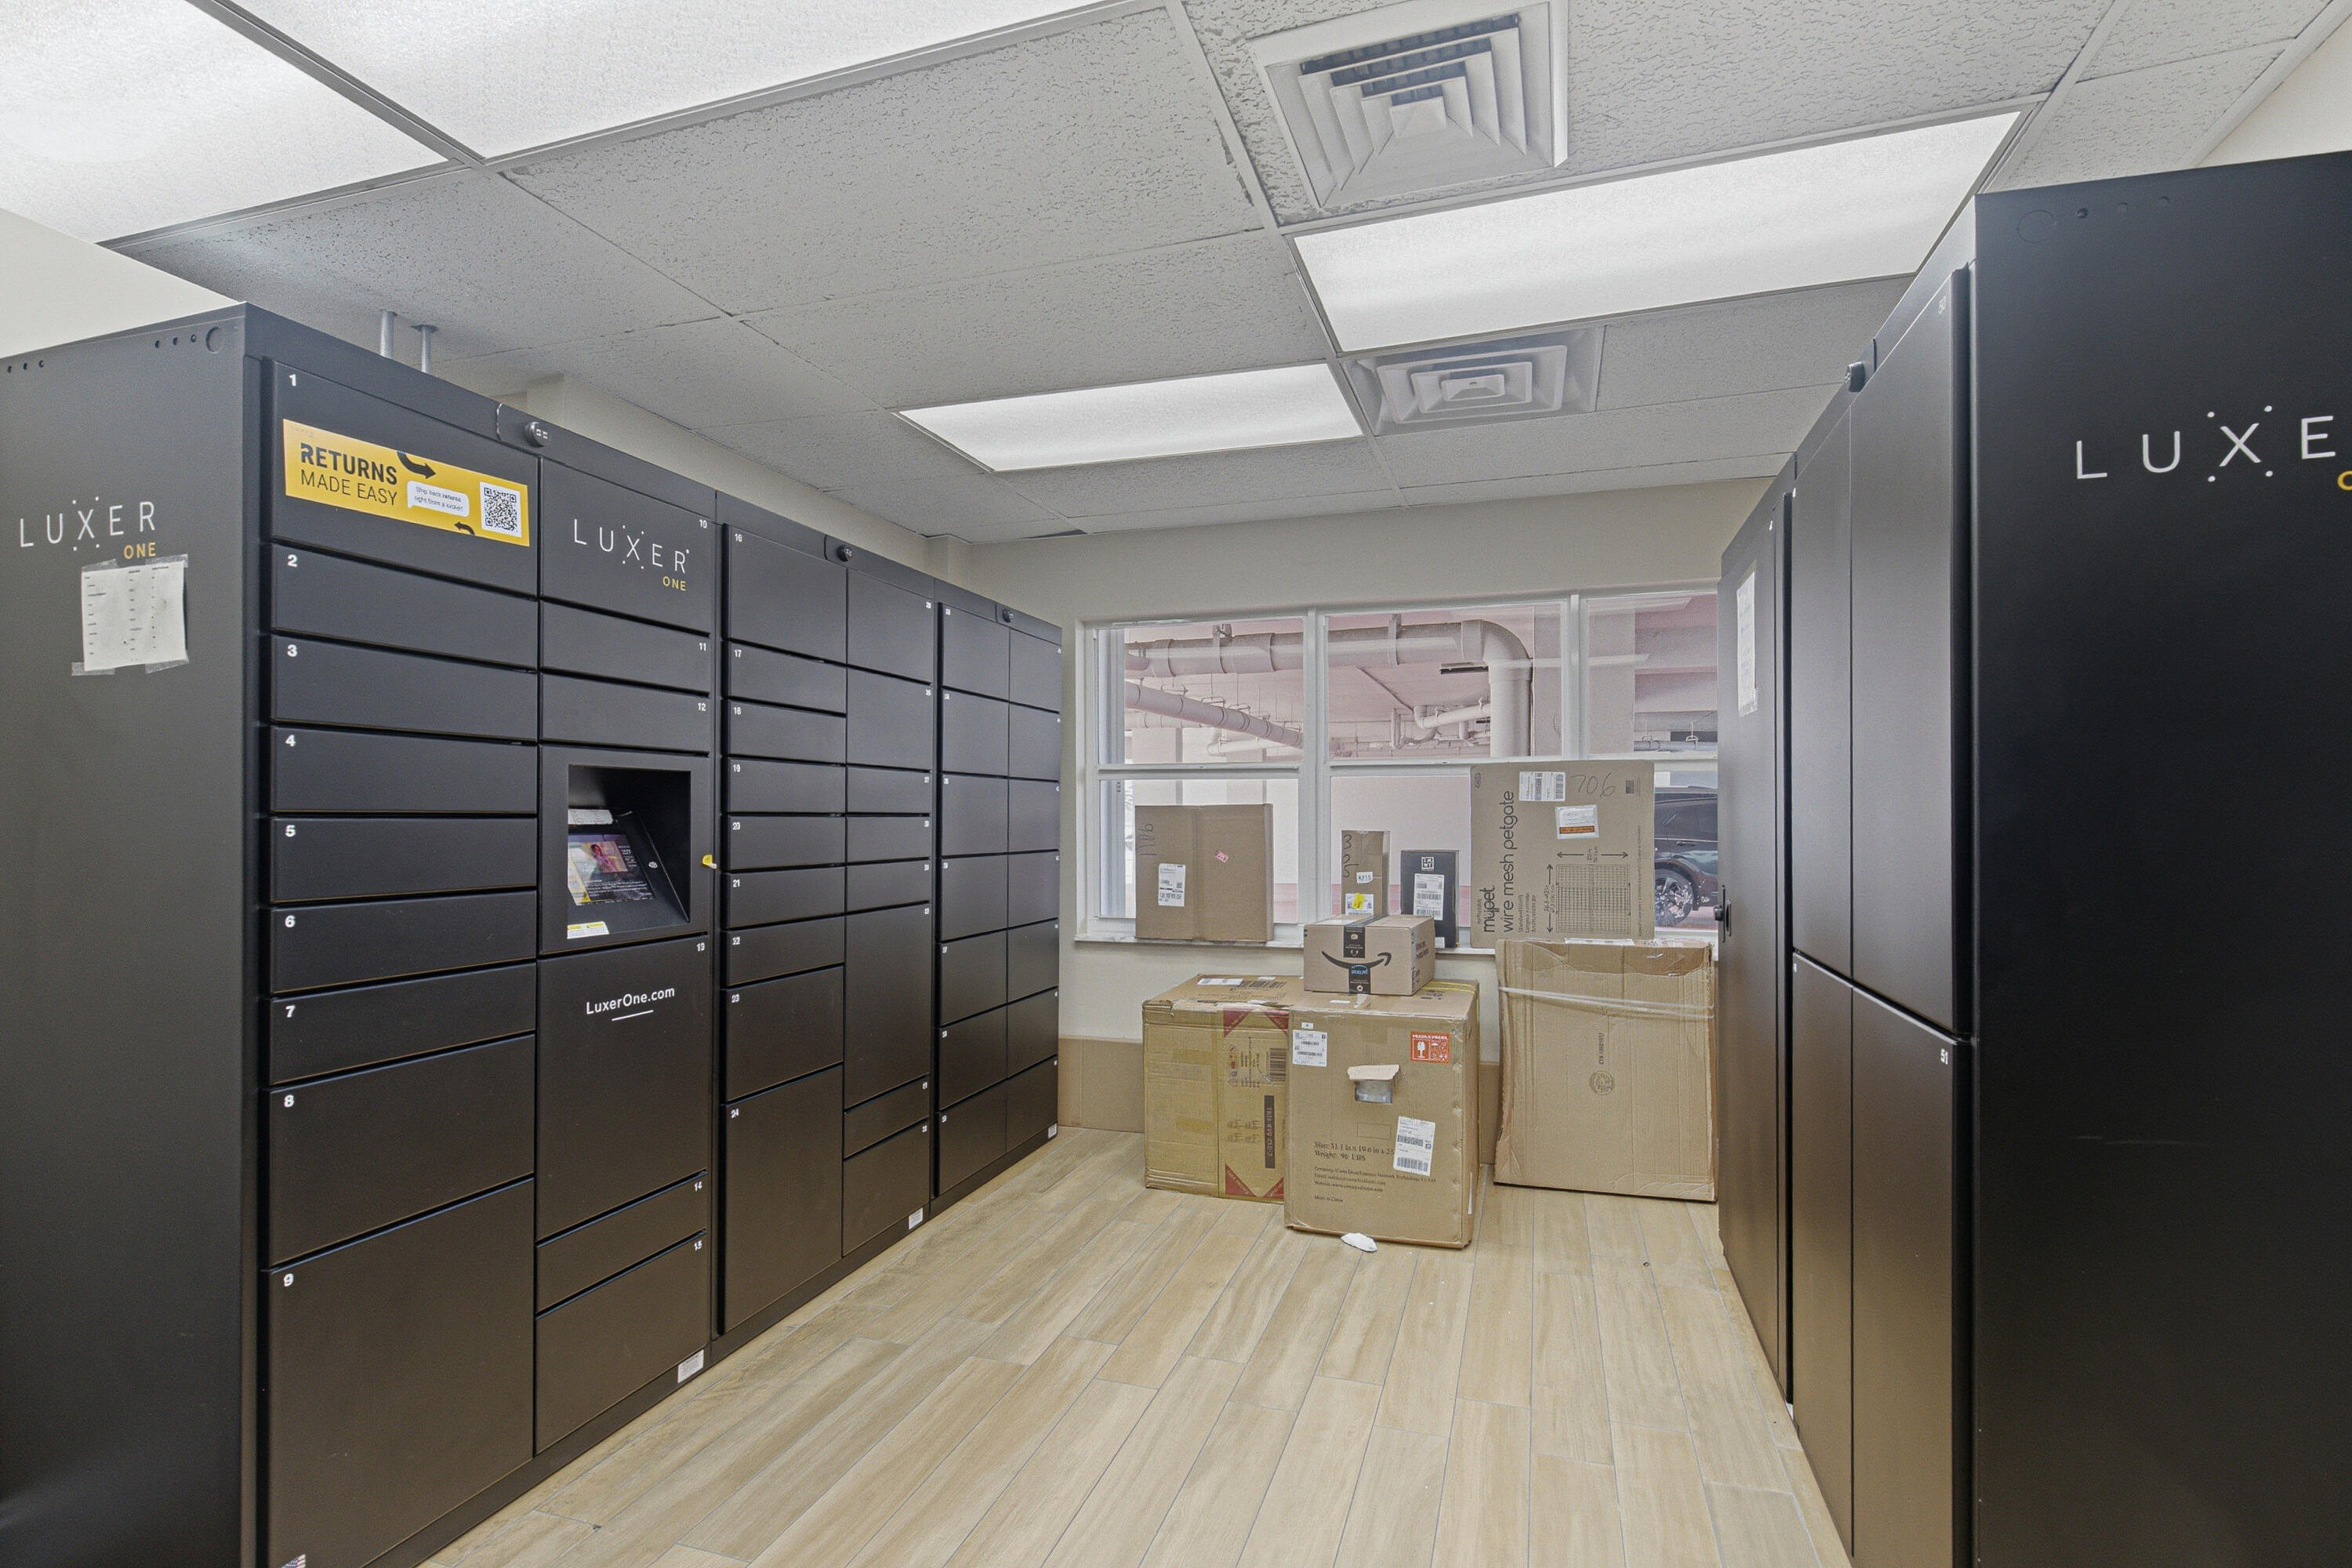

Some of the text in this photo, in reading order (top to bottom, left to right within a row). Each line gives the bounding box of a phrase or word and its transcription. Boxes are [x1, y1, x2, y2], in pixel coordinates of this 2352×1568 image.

[289, 374, 296, 387] 1
[300, 442, 397, 485] RETURNS
[301, 470, 397, 506] MADE EASY
[20, 497, 155, 550] LUXER
[699, 519, 708, 529] 10
[124, 543, 156, 559] ONE
[574, 519, 687, 573] LUXER
[287, 554, 298, 568] 2
[662, 576, 686, 591] ONE
[287, 644, 298, 657] 3
[699, 642, 706, 652] 11
[734, 649, 742, 658] 17
[698, 702, 706, 712] 12
[733, 706, 742, 715] 18
[285, 735, 296, 747] 4
[1570, 772, 1616, 797] 706
[285, 825, 296, 837] 5
[1499, 791, 1518, 932] wire mesh petgate
[732, 879, 740, 887] 21
[1479, 887, 1500, 932] mypet
[285, 915, 296, 928] 6
[696, 942, 706, 952] 13
[586, 986, 675, 1015] LuxerOne.com
[285, 1005, 296, 1018] 7
[1940, 1048, 1948, 1065] 51
[285, 1094, 295, 1108] 8
[694, 1181, 702, 1192] 14
[694, 1240, 702, 1251] 15
[283, 1273, 294, 1287] 9
